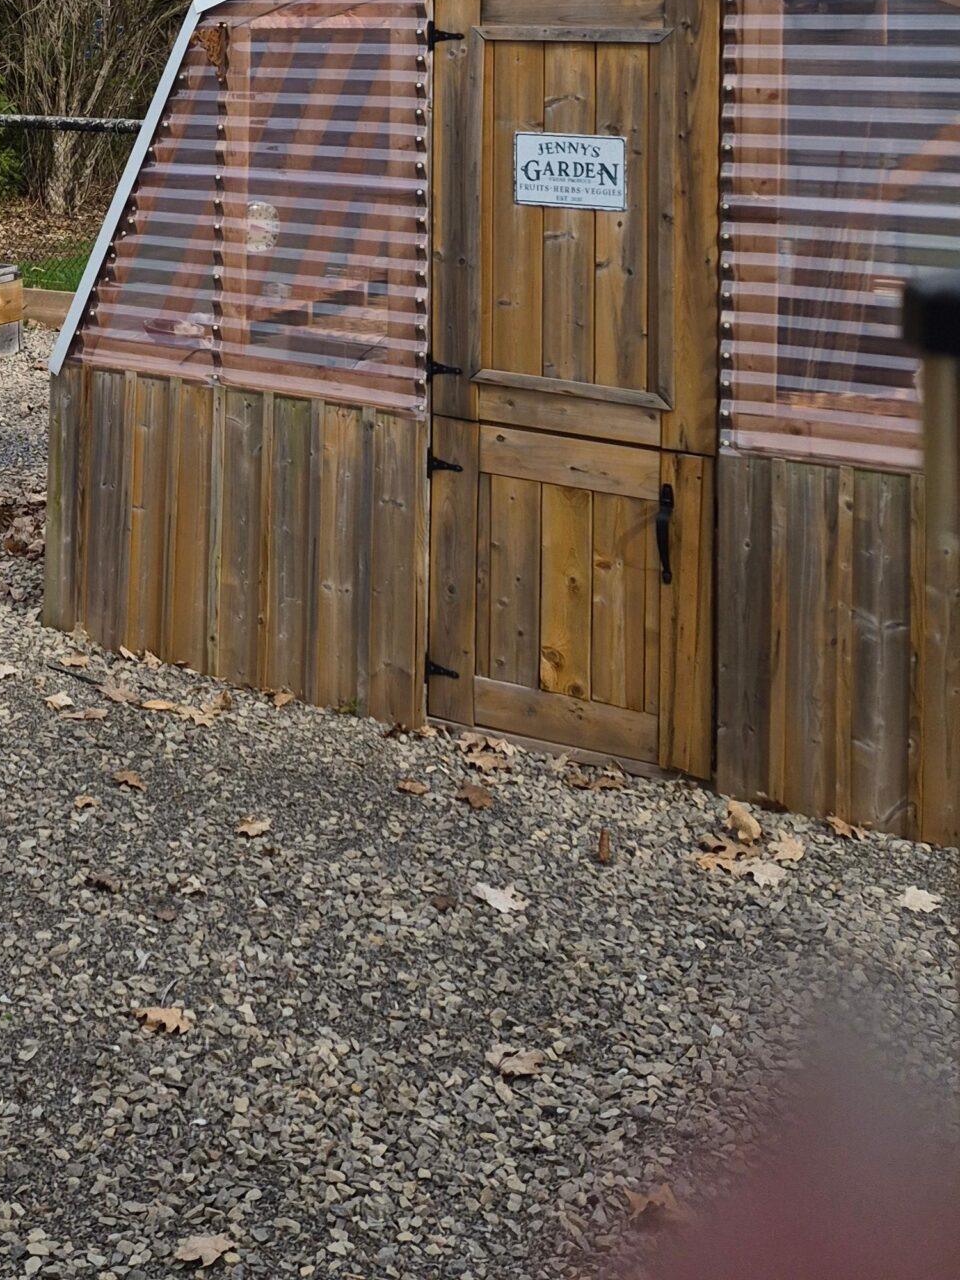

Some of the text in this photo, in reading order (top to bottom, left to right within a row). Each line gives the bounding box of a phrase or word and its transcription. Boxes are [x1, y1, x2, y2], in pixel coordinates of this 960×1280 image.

[538, 141, 601, 158] JENNYS
[521, 159, 620, 186] GARDEN
[520, 183, 622, 197] FRUITS HERBS VEGGIES
